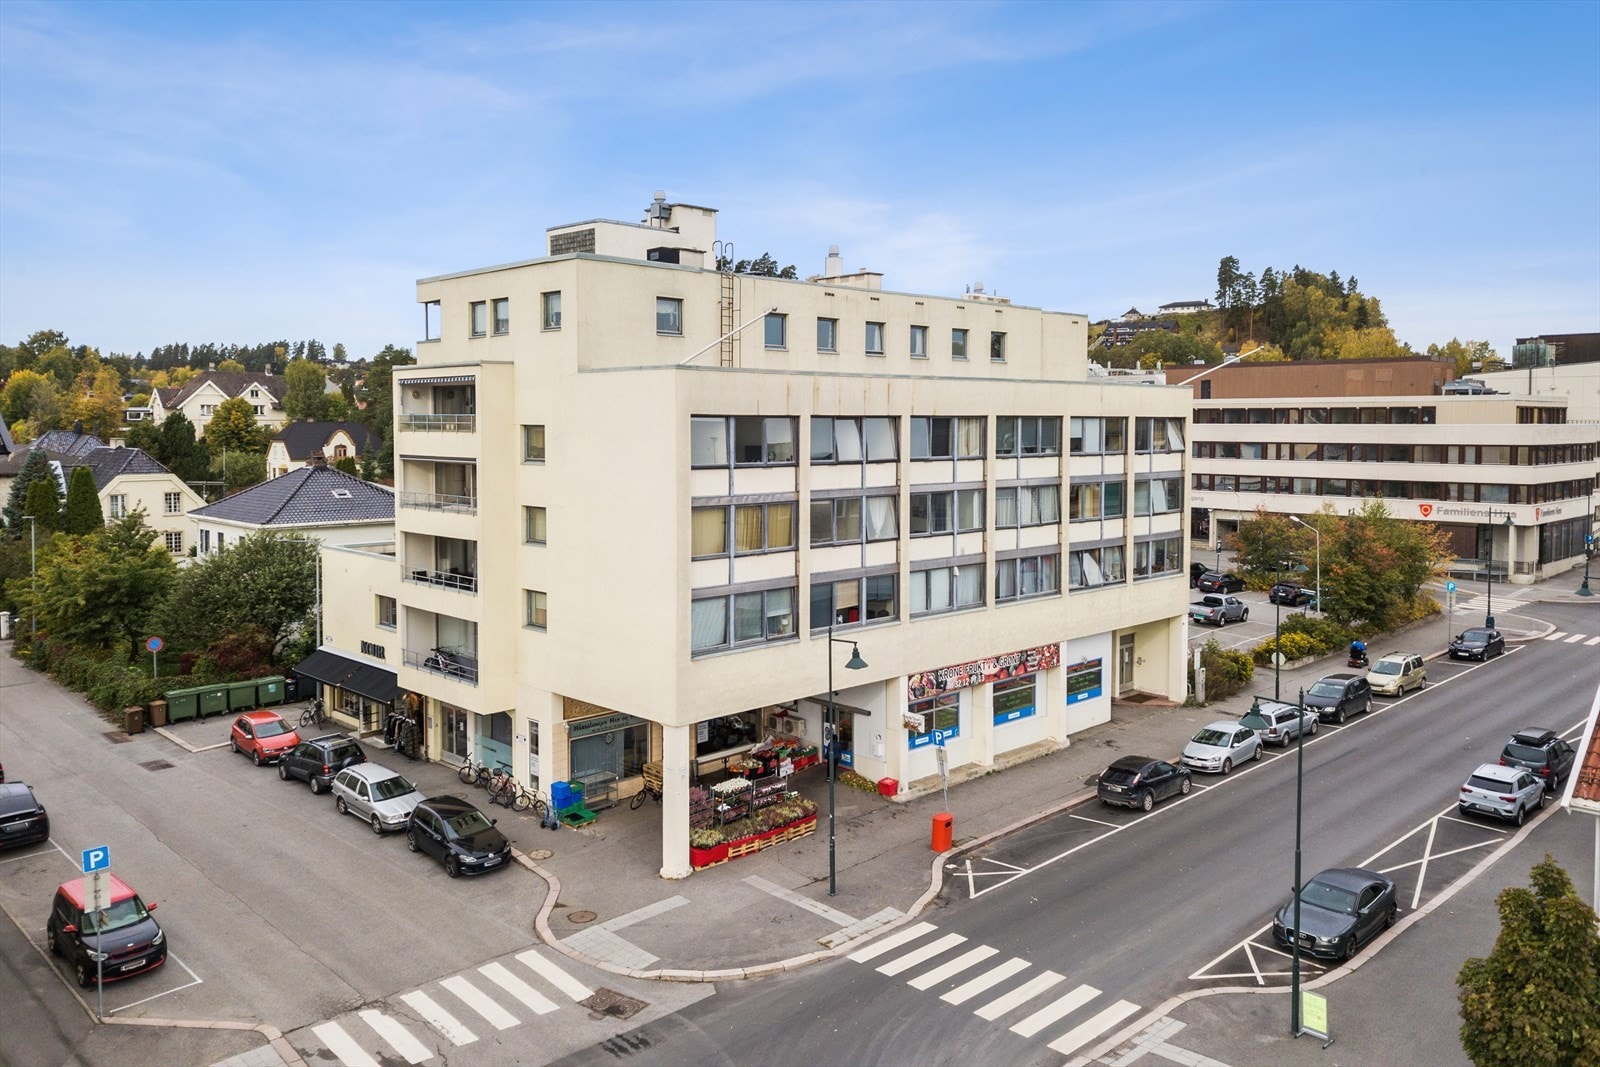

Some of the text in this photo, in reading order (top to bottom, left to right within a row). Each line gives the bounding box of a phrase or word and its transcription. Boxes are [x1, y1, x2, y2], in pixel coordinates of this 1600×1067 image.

[1436, 506, 1491, 517] Familiens
[937, 665, 963, 681] KRONE
[965, 661, 986, 675] FRUKT
[935, 731, 942, 744] P
[90, 850, 104, 869] P
